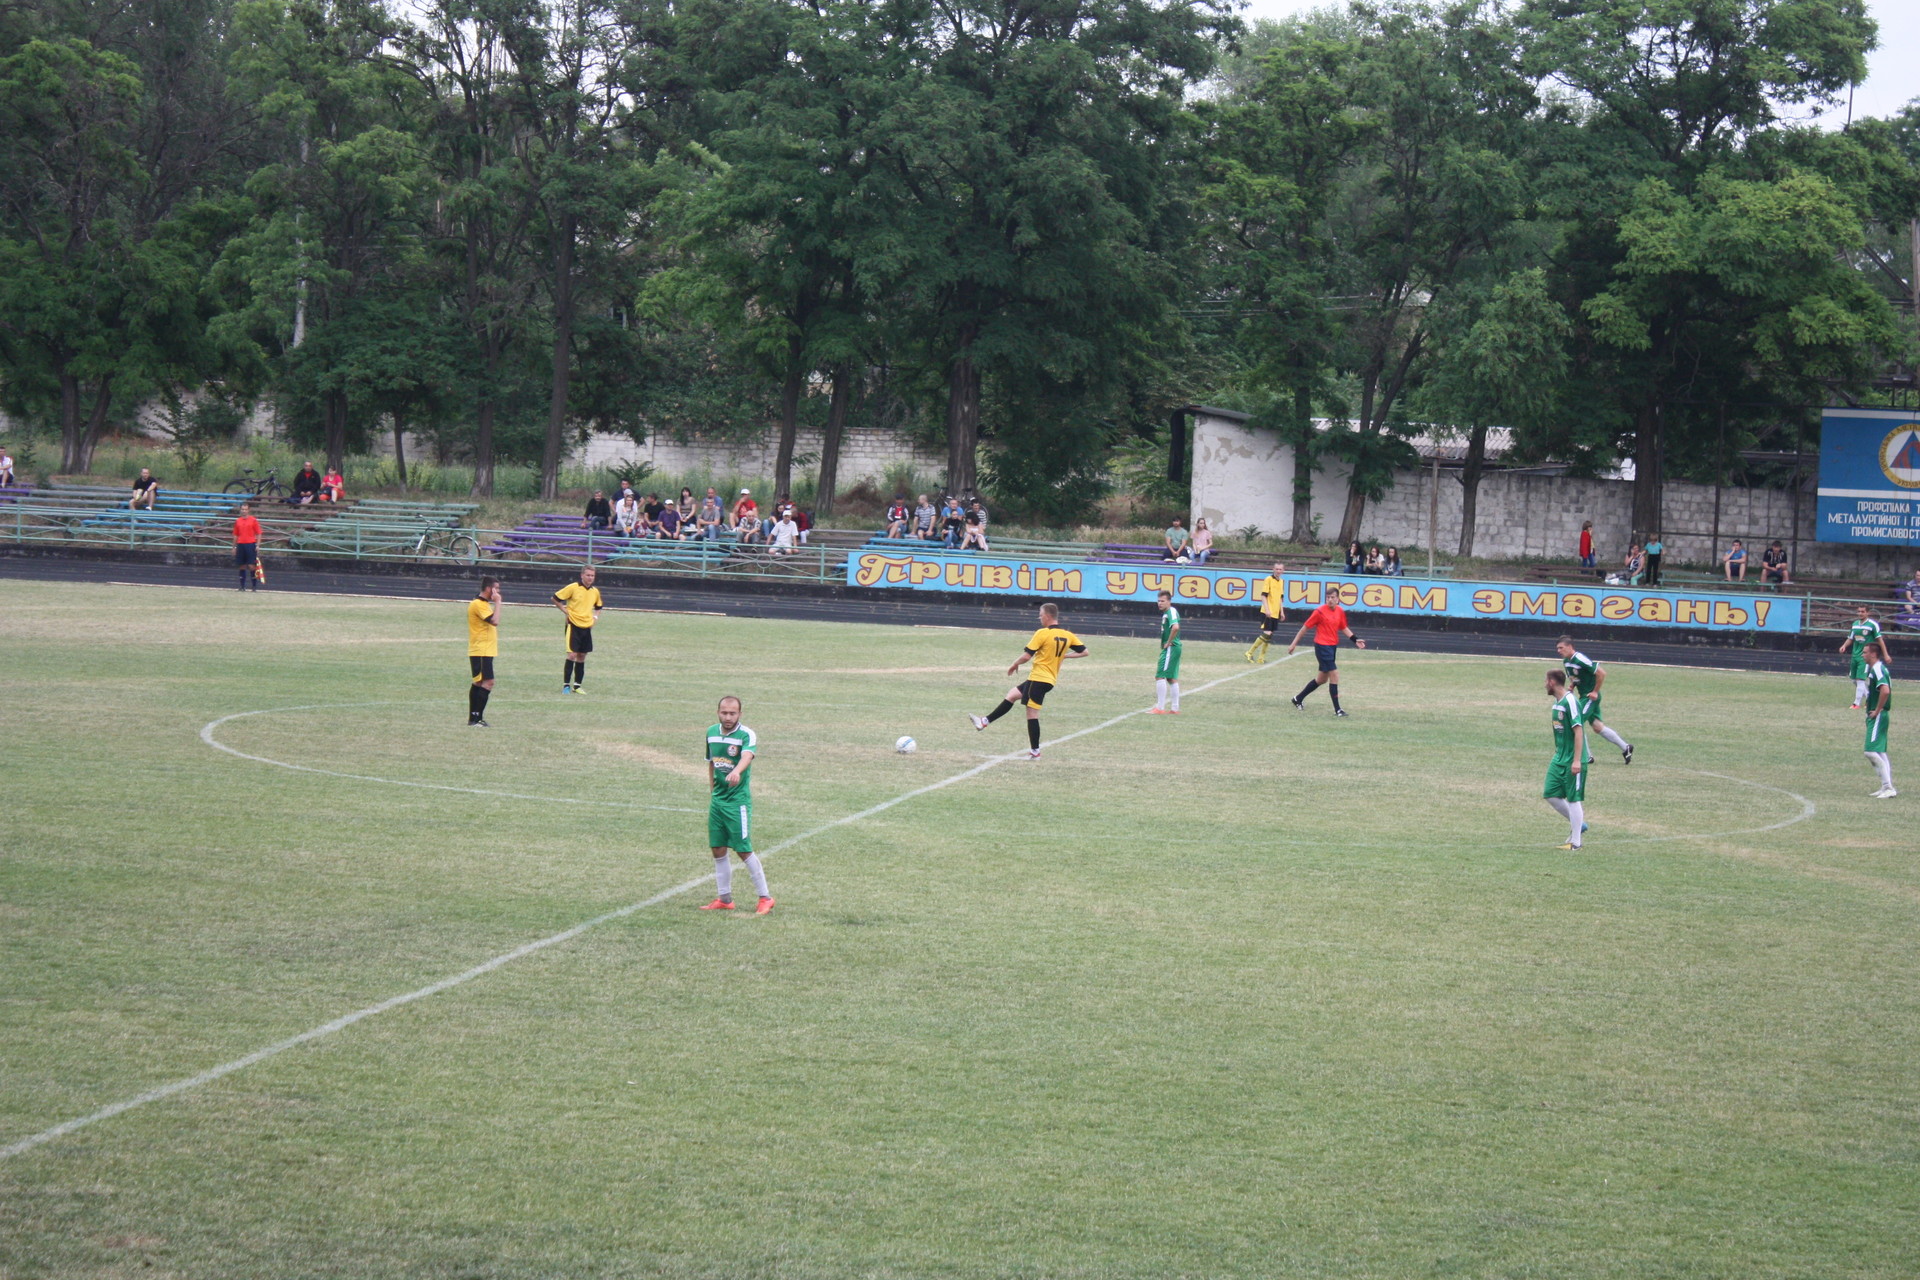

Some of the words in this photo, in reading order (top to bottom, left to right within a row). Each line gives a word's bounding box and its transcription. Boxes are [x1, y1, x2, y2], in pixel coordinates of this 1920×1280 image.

[1857, 501, 1910, 513] ПРОФСПІЛКА
[1828, 513, 1900, 526] МЕТАЛУРГІЙНОЇ
[855, 553, 1082, 592] Привіт
[1473, 589, 1771, 627] змагань!
[1054, 636, 1068, 657] 17
